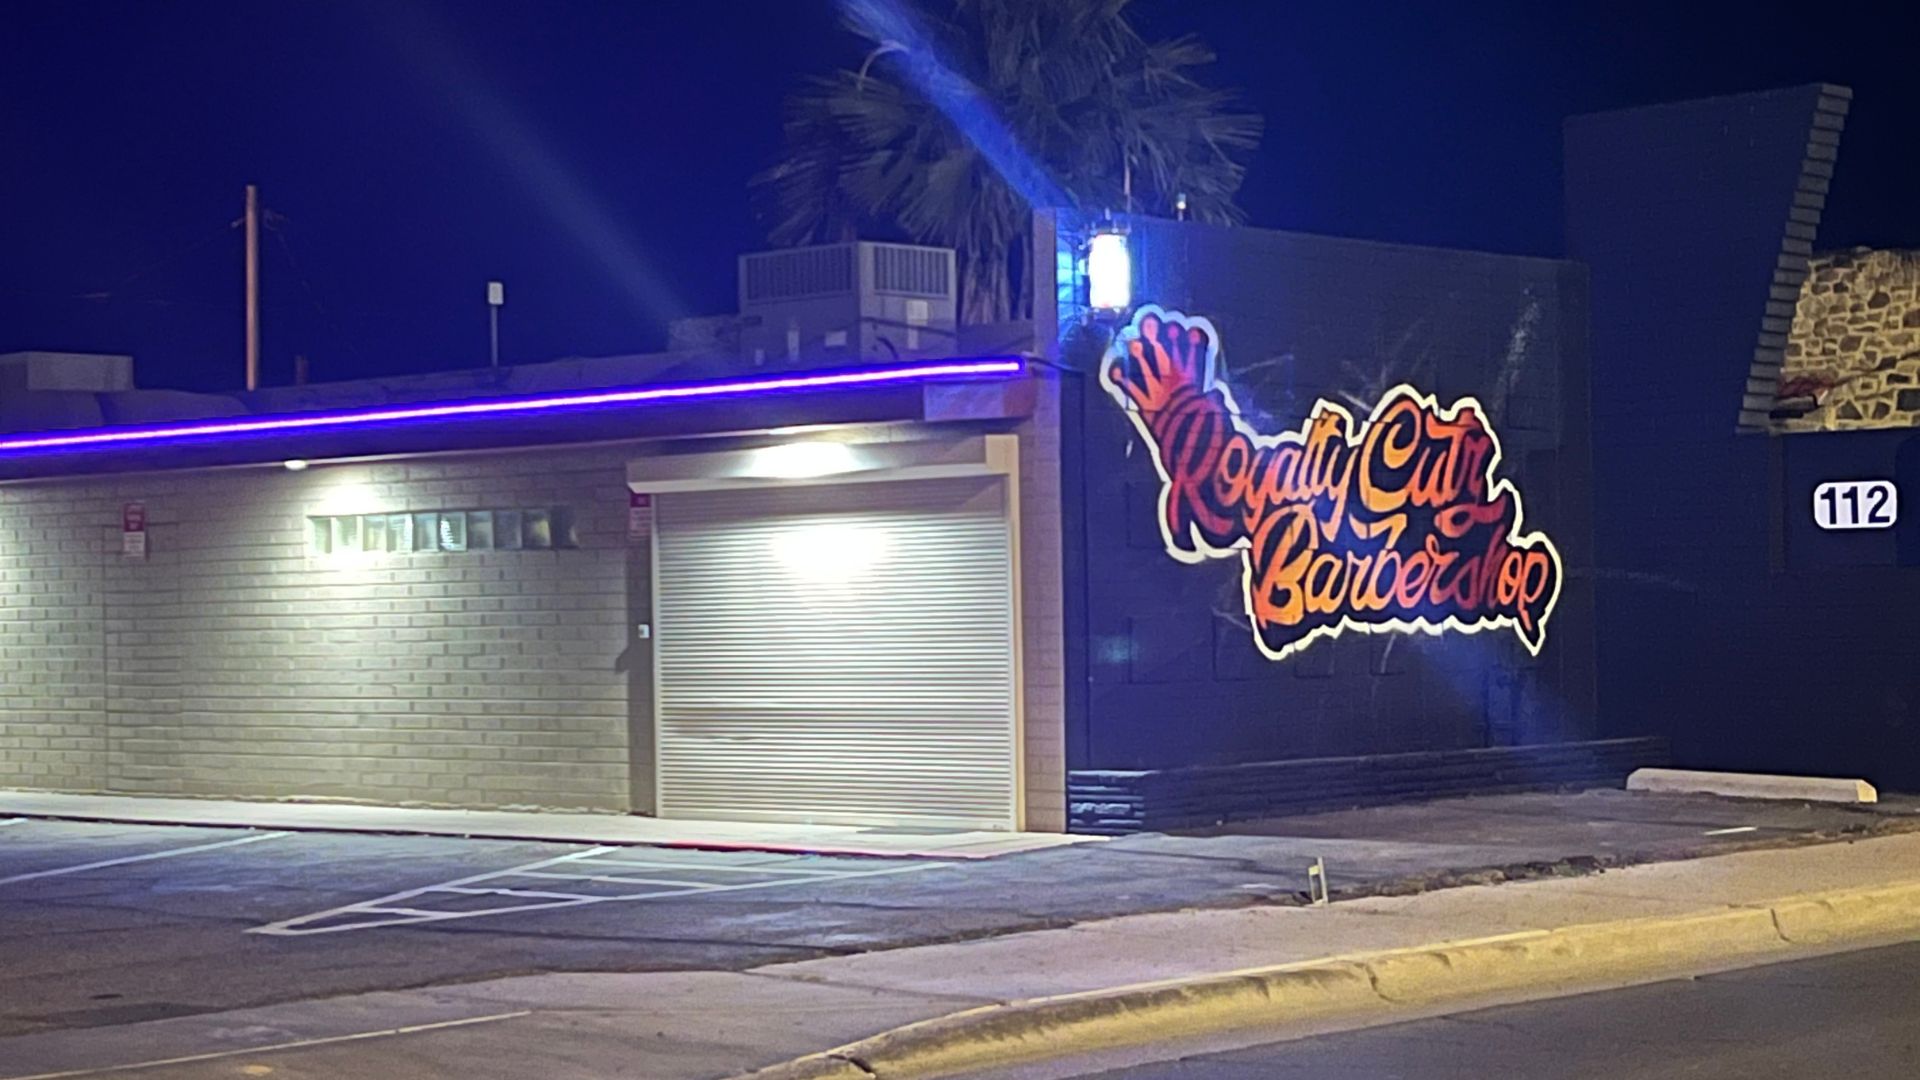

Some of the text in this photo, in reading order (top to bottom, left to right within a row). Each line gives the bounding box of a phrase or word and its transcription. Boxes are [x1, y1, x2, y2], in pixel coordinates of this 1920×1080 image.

[1162, 397, 1360, 542] Royalty
[1820, 485, 1891, 525] 112
[1251, 501, 1549, 631] Barbershop
